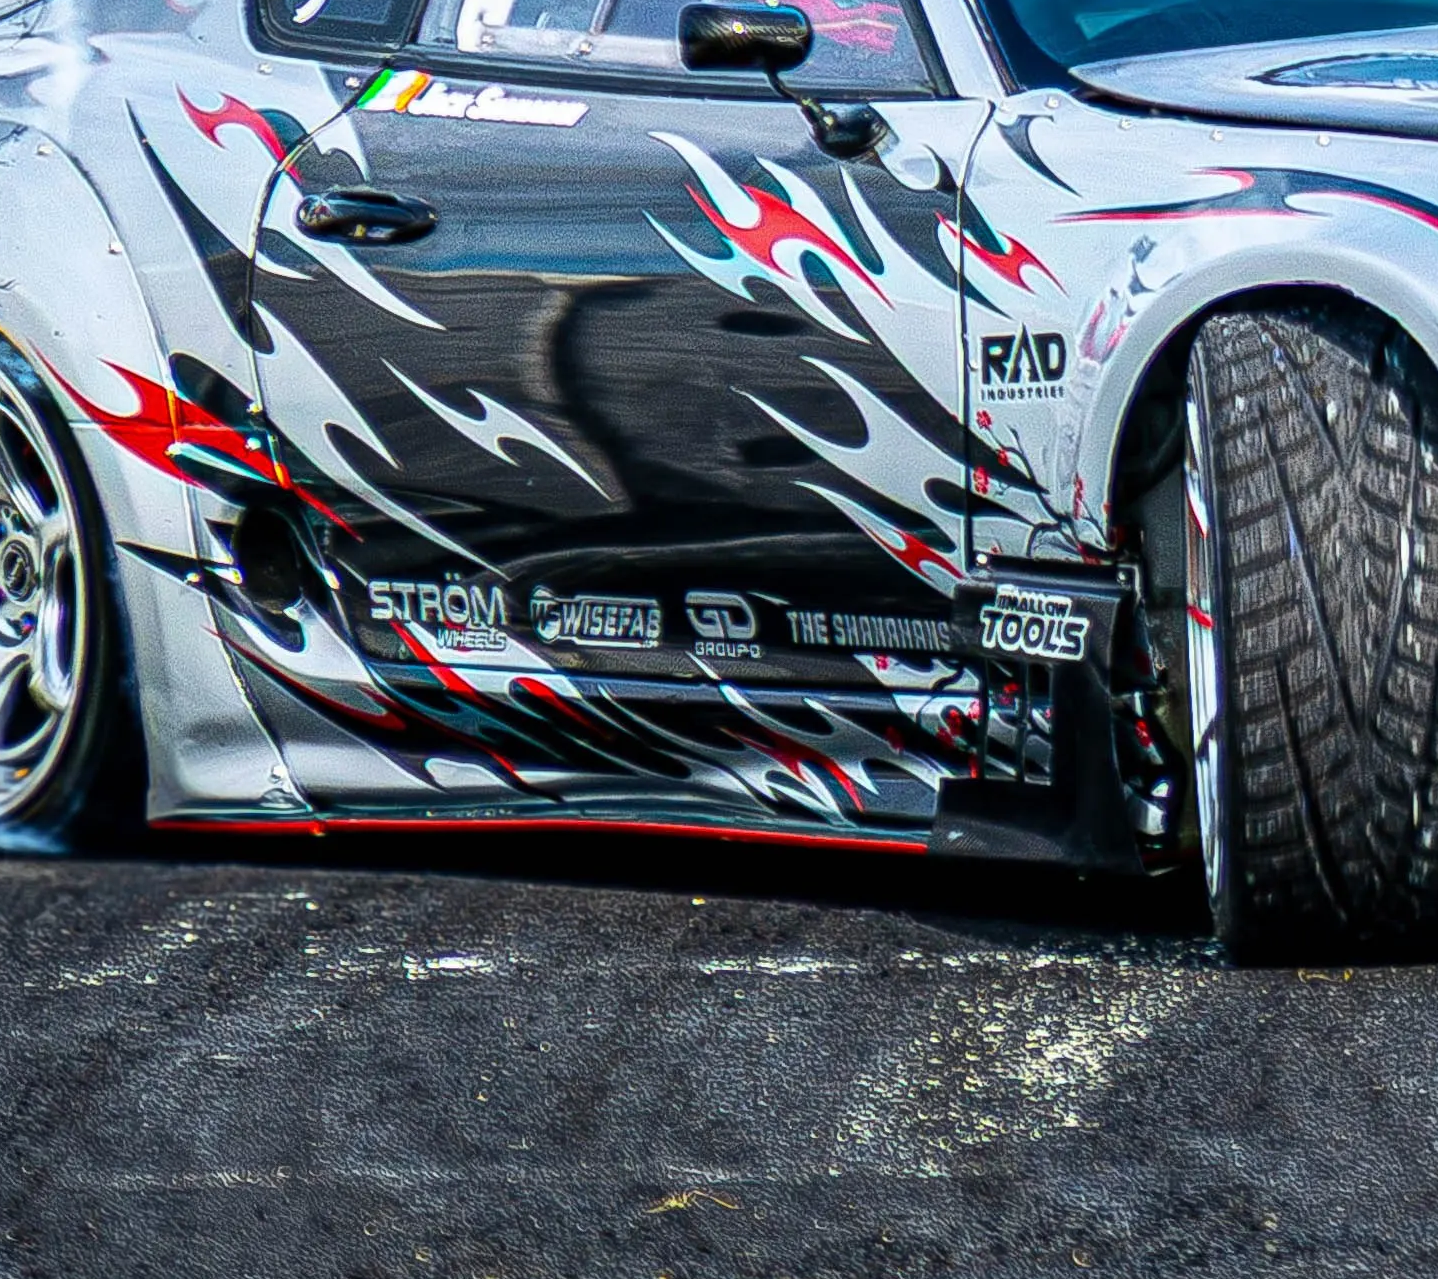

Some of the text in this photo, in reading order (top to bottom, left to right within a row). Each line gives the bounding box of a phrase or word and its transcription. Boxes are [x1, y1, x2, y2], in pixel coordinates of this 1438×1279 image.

[980, 322, 1066, 385] RAD
[368, 572, 508, 626] STRÖM
[436, 628, 508, 651] WHEELS
[562, 603, 662, 639] WISEFAB
[785, 611, 830, 645] THE
[982, 609, 1086, 657] TOOLS
